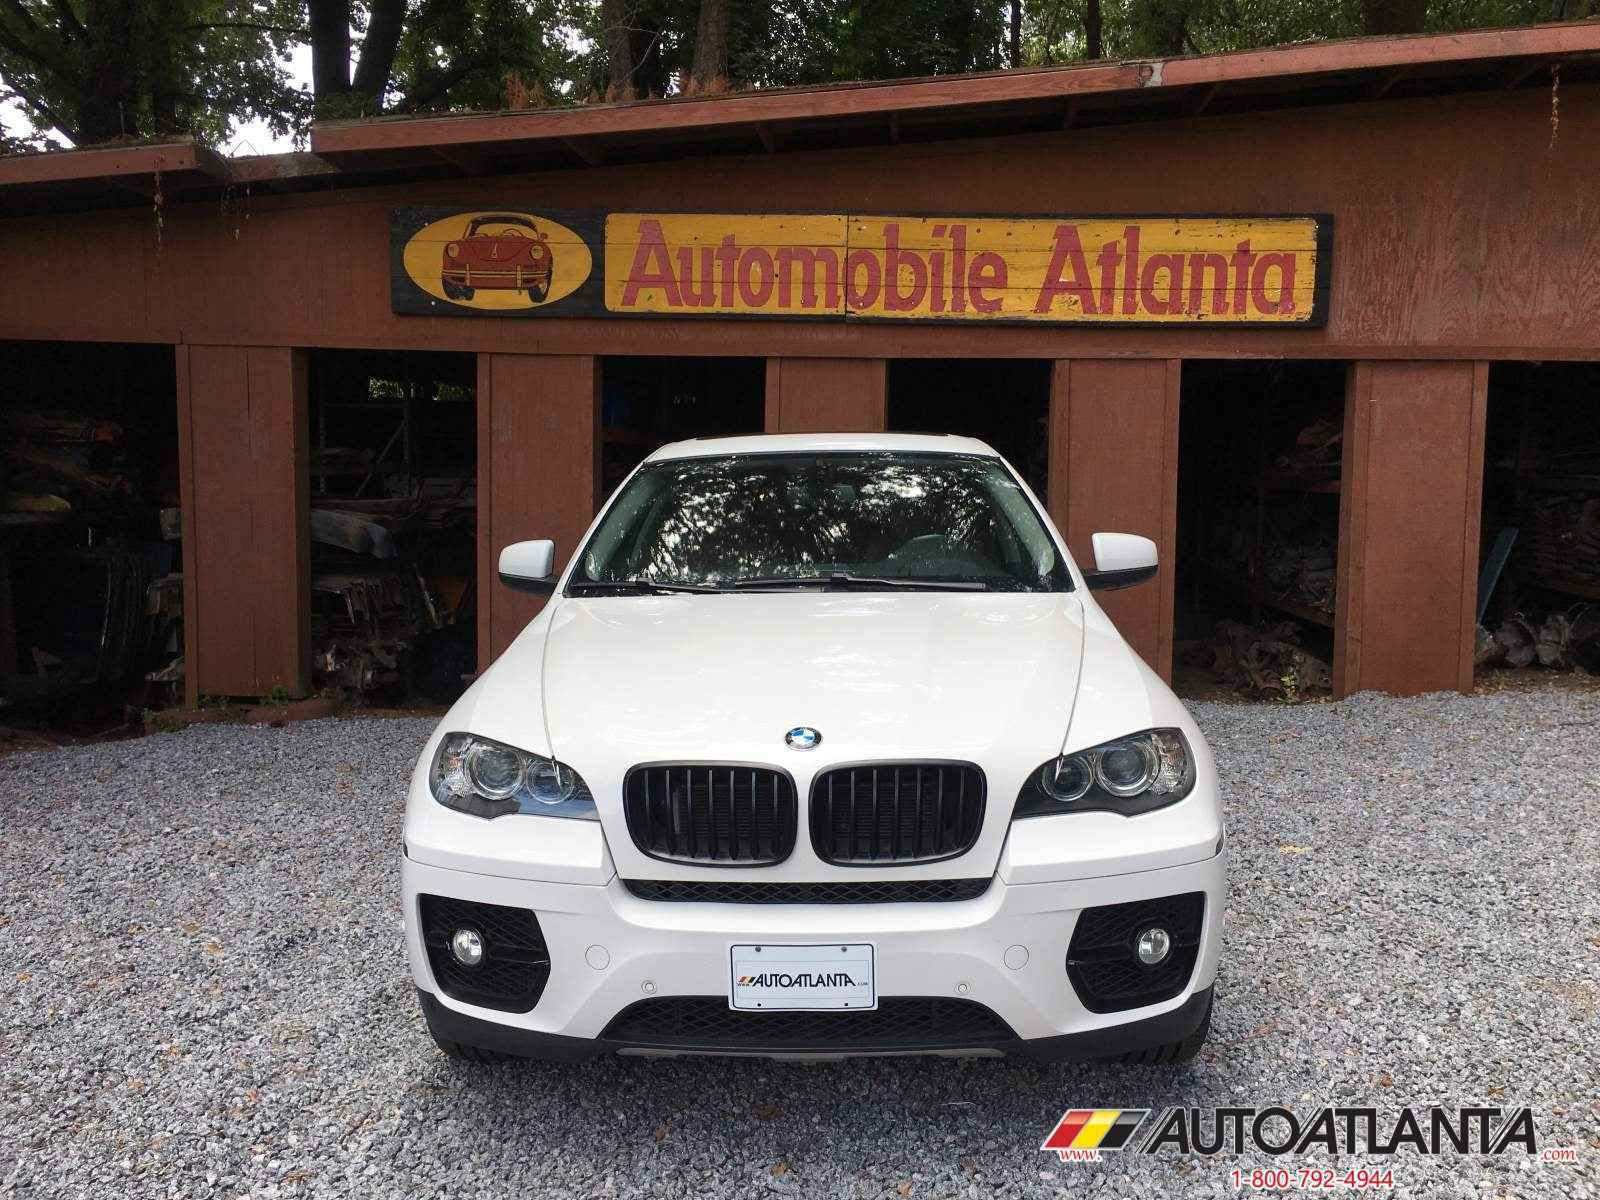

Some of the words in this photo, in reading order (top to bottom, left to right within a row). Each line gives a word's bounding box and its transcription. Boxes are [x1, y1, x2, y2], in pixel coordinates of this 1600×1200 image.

[624, 218, 1007, 314] Automobile
[1036, 223, 1296, 317] Atlanta
[752, 973, 857, 988] AUTOATLANTA
